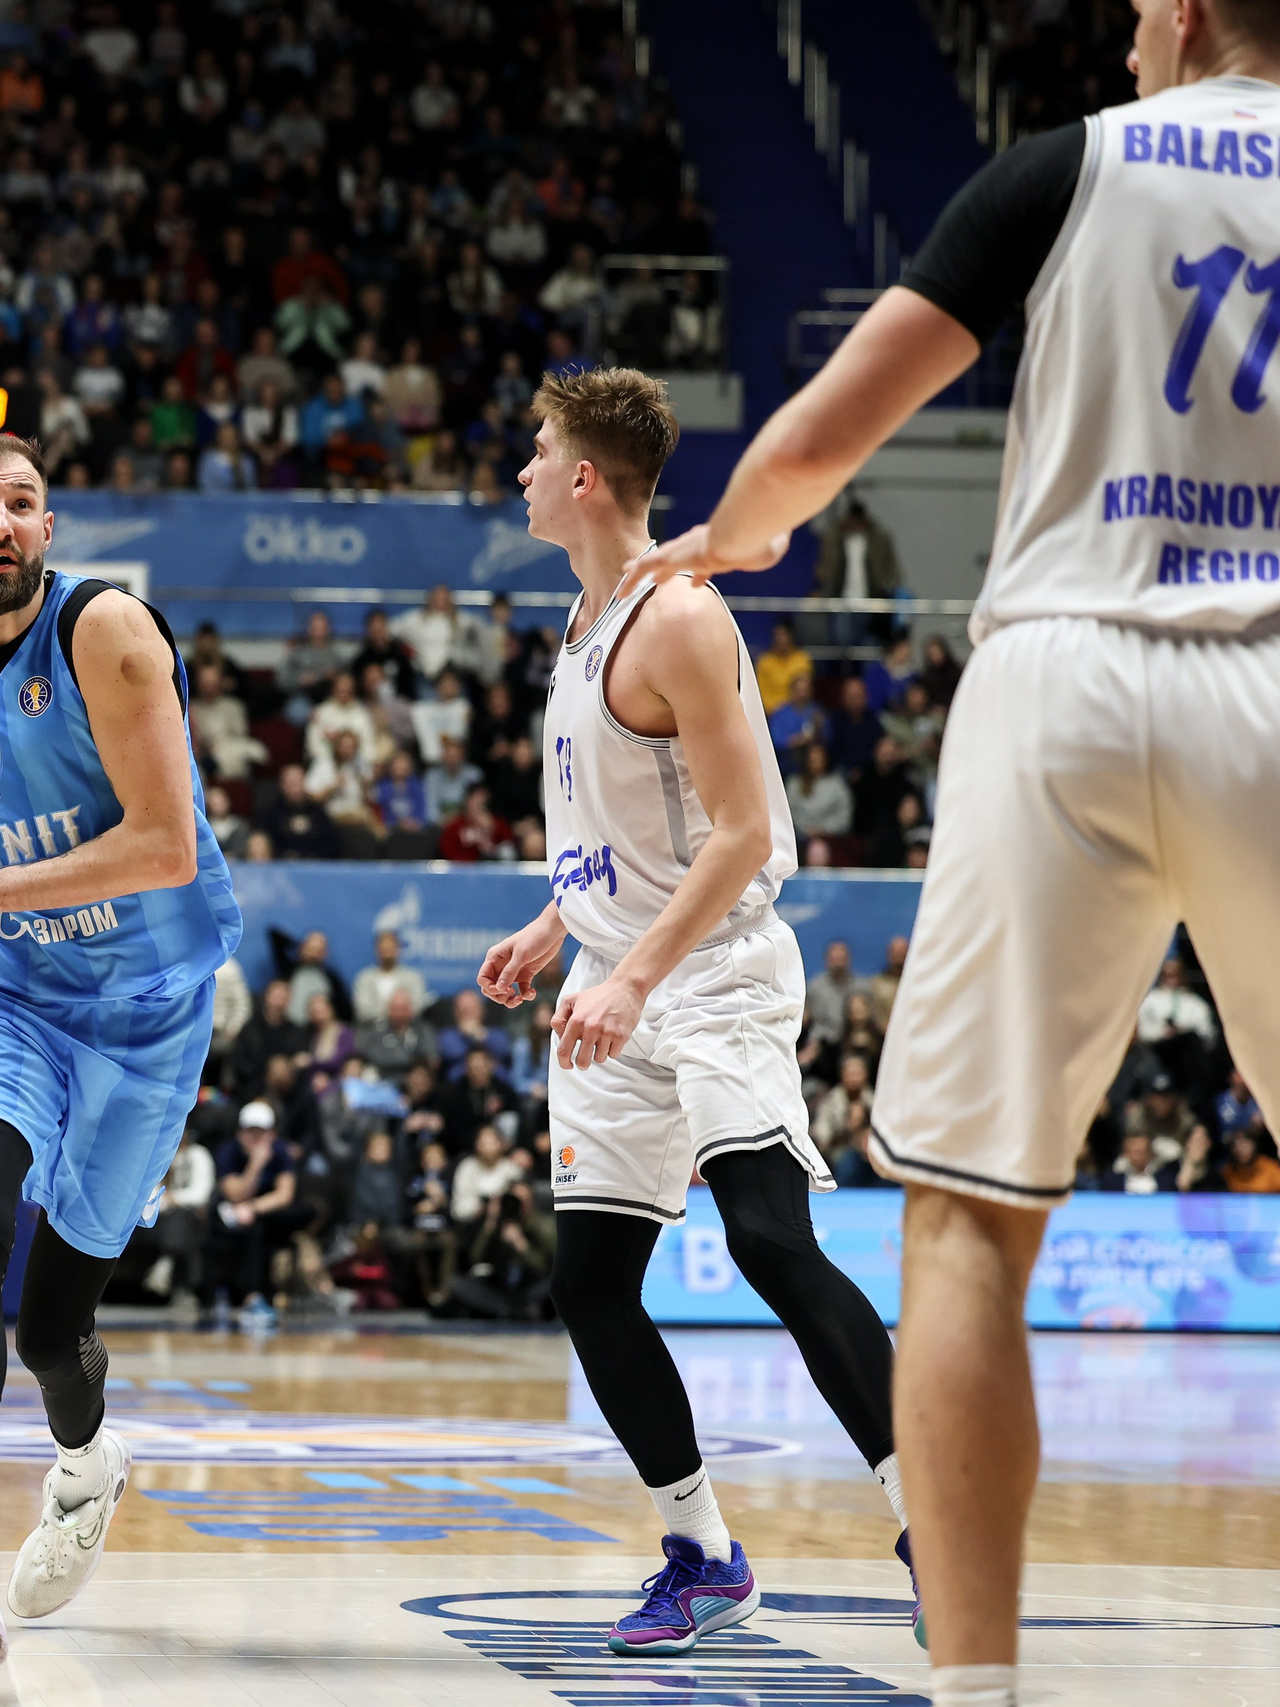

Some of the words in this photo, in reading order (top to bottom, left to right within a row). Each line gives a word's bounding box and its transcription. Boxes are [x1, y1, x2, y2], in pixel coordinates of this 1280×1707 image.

[1124, 122, 1280, 179] BALAS
[1164, 244, 1280, 414] 11
[1103, 474, 1280, 530] KRASNOY
[555, 1174, 578, 1184] ENISEY
